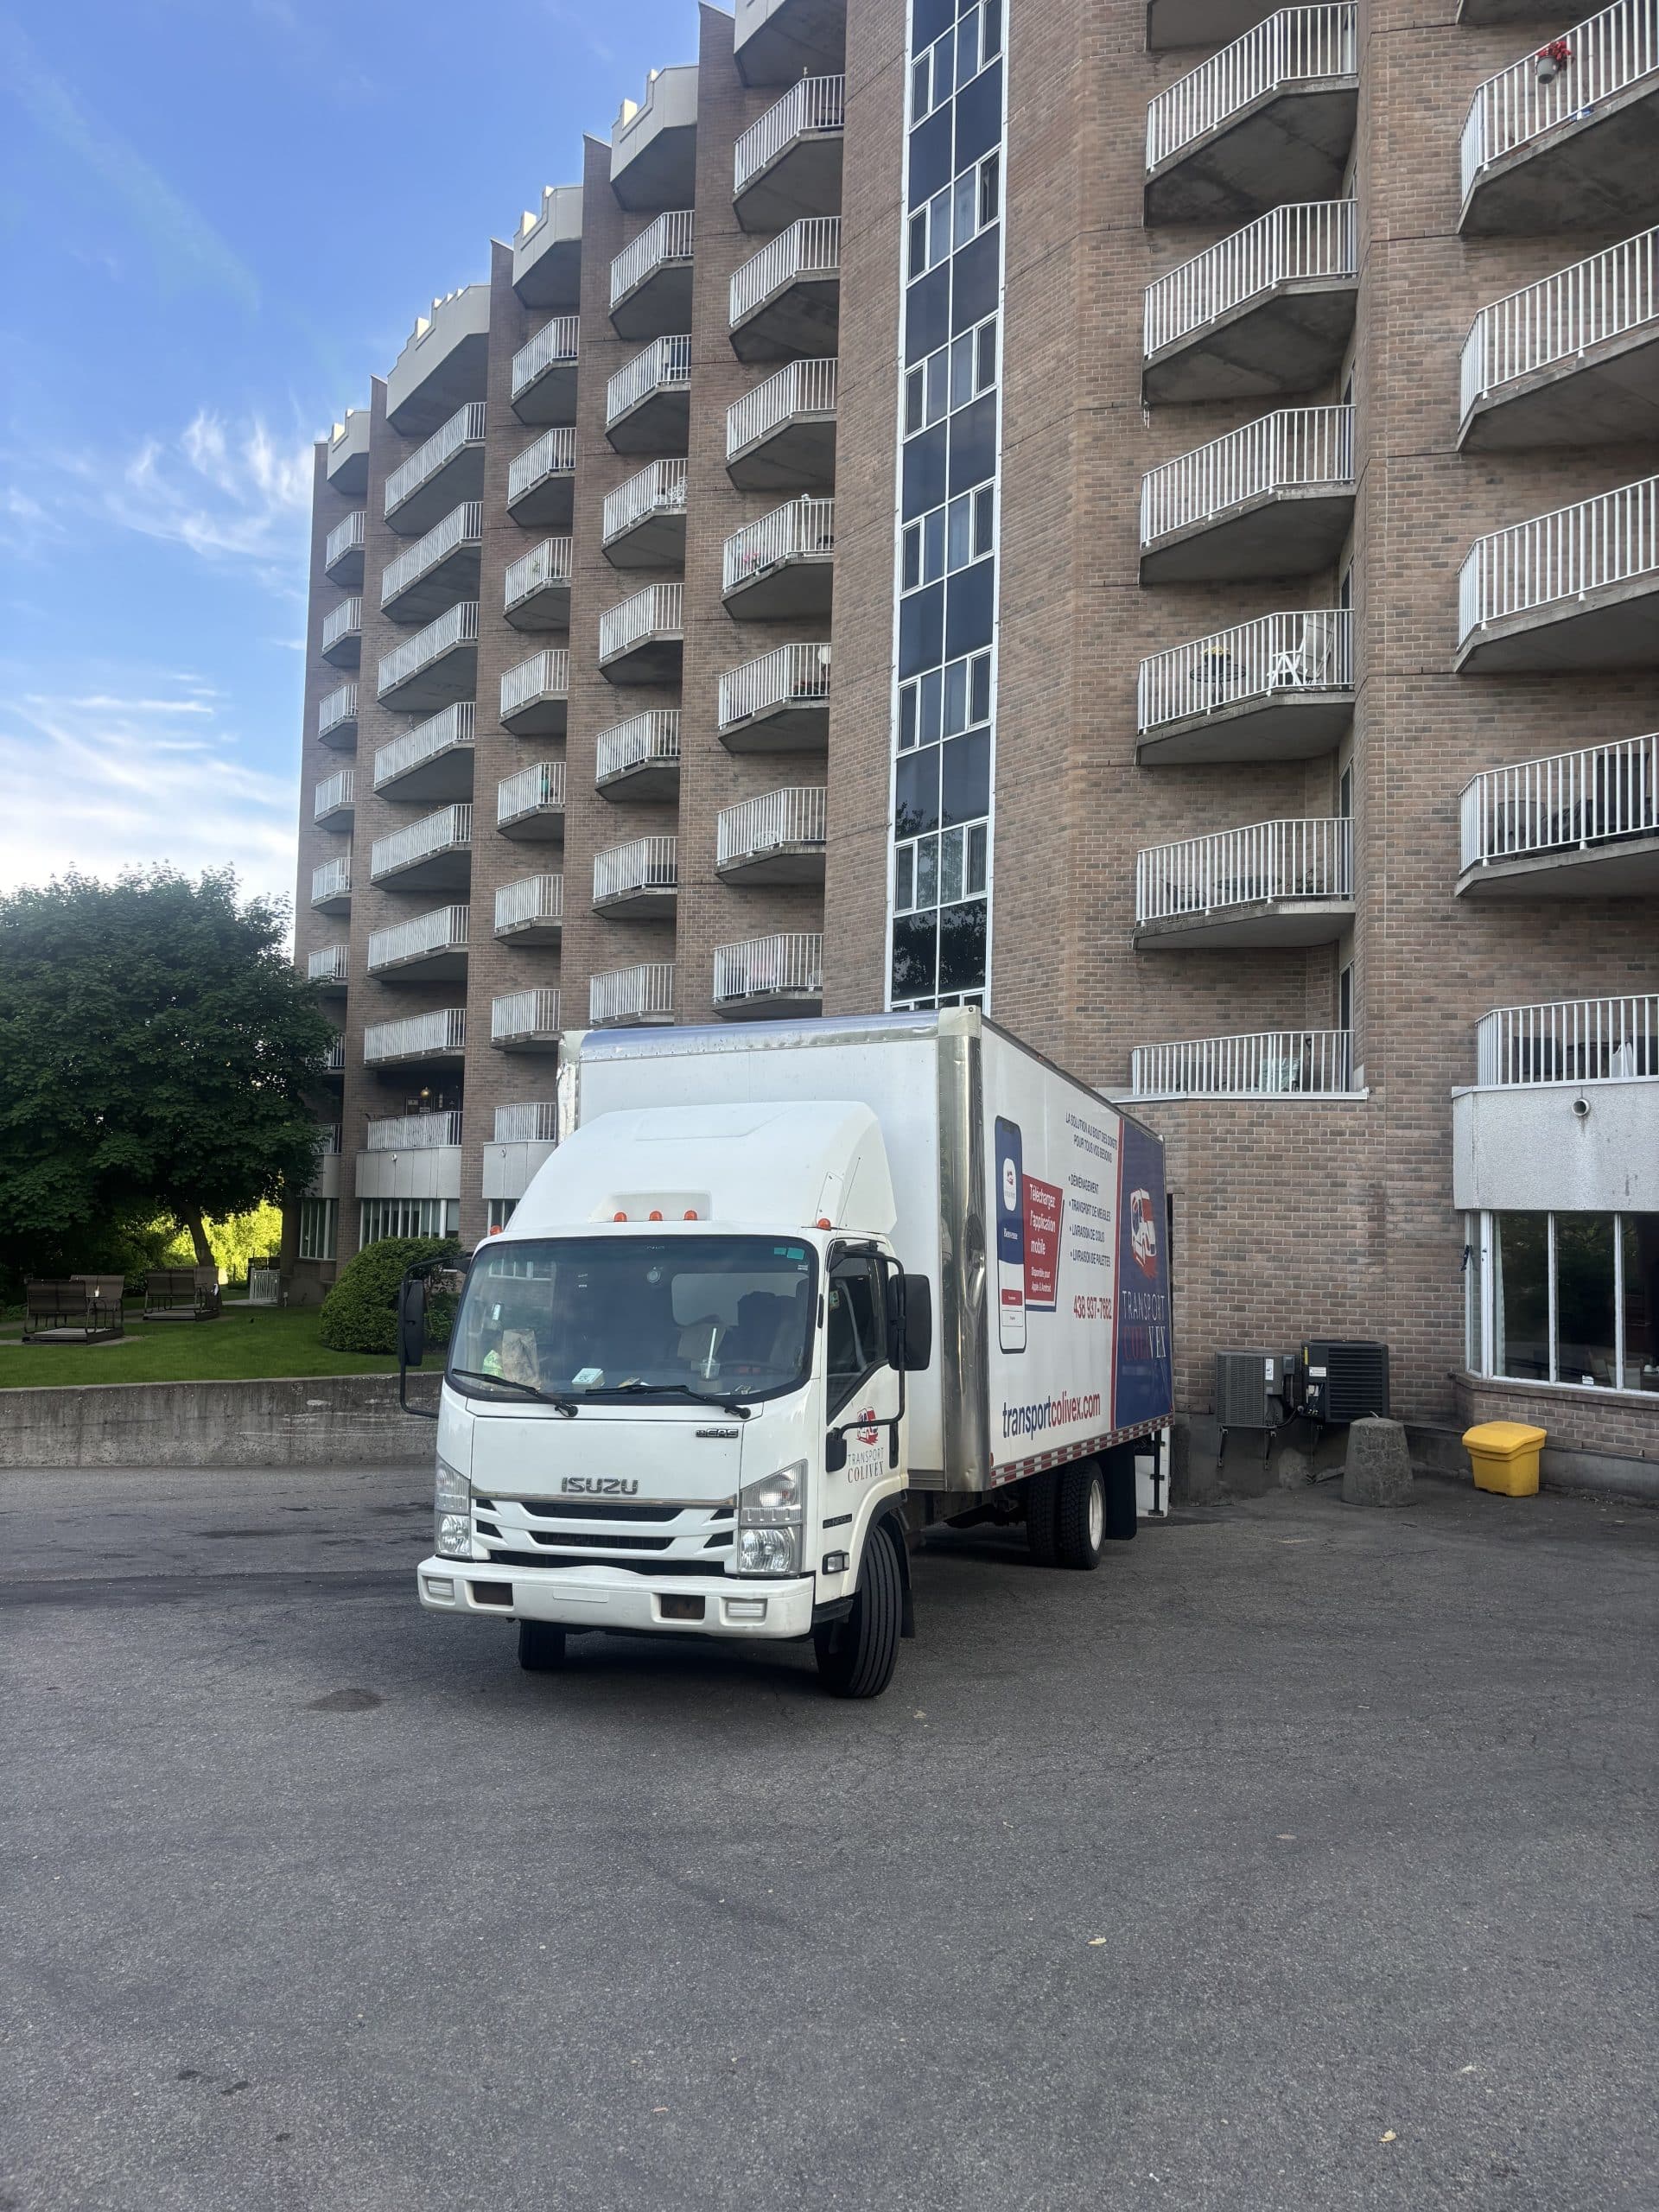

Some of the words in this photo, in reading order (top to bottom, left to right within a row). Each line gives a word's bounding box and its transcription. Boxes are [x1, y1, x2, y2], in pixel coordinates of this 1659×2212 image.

[1030, 1183, 1056, 1210] Téléchargez
[1071, 1198, 1092, 1216] TRANSPORT
[1072, 1224, 1090, 1240] LIVRAISON
[1031, 1238, 1046, 1255] mobile
[1073, 1249, 1091, 1264] LIVRAISON
[1073, 1294, 1086, 1319] 438
[1122, 1290, 1165, 1321] TRANSPORT
[1002, 1390, 1101, 1440] transportcolivex.com
[848, 1446, 884, 1465] TRANSPORT
[848, 1461, 884, 1484] COLIVEX
[562, 1477, 639, 1495] ISUZU
